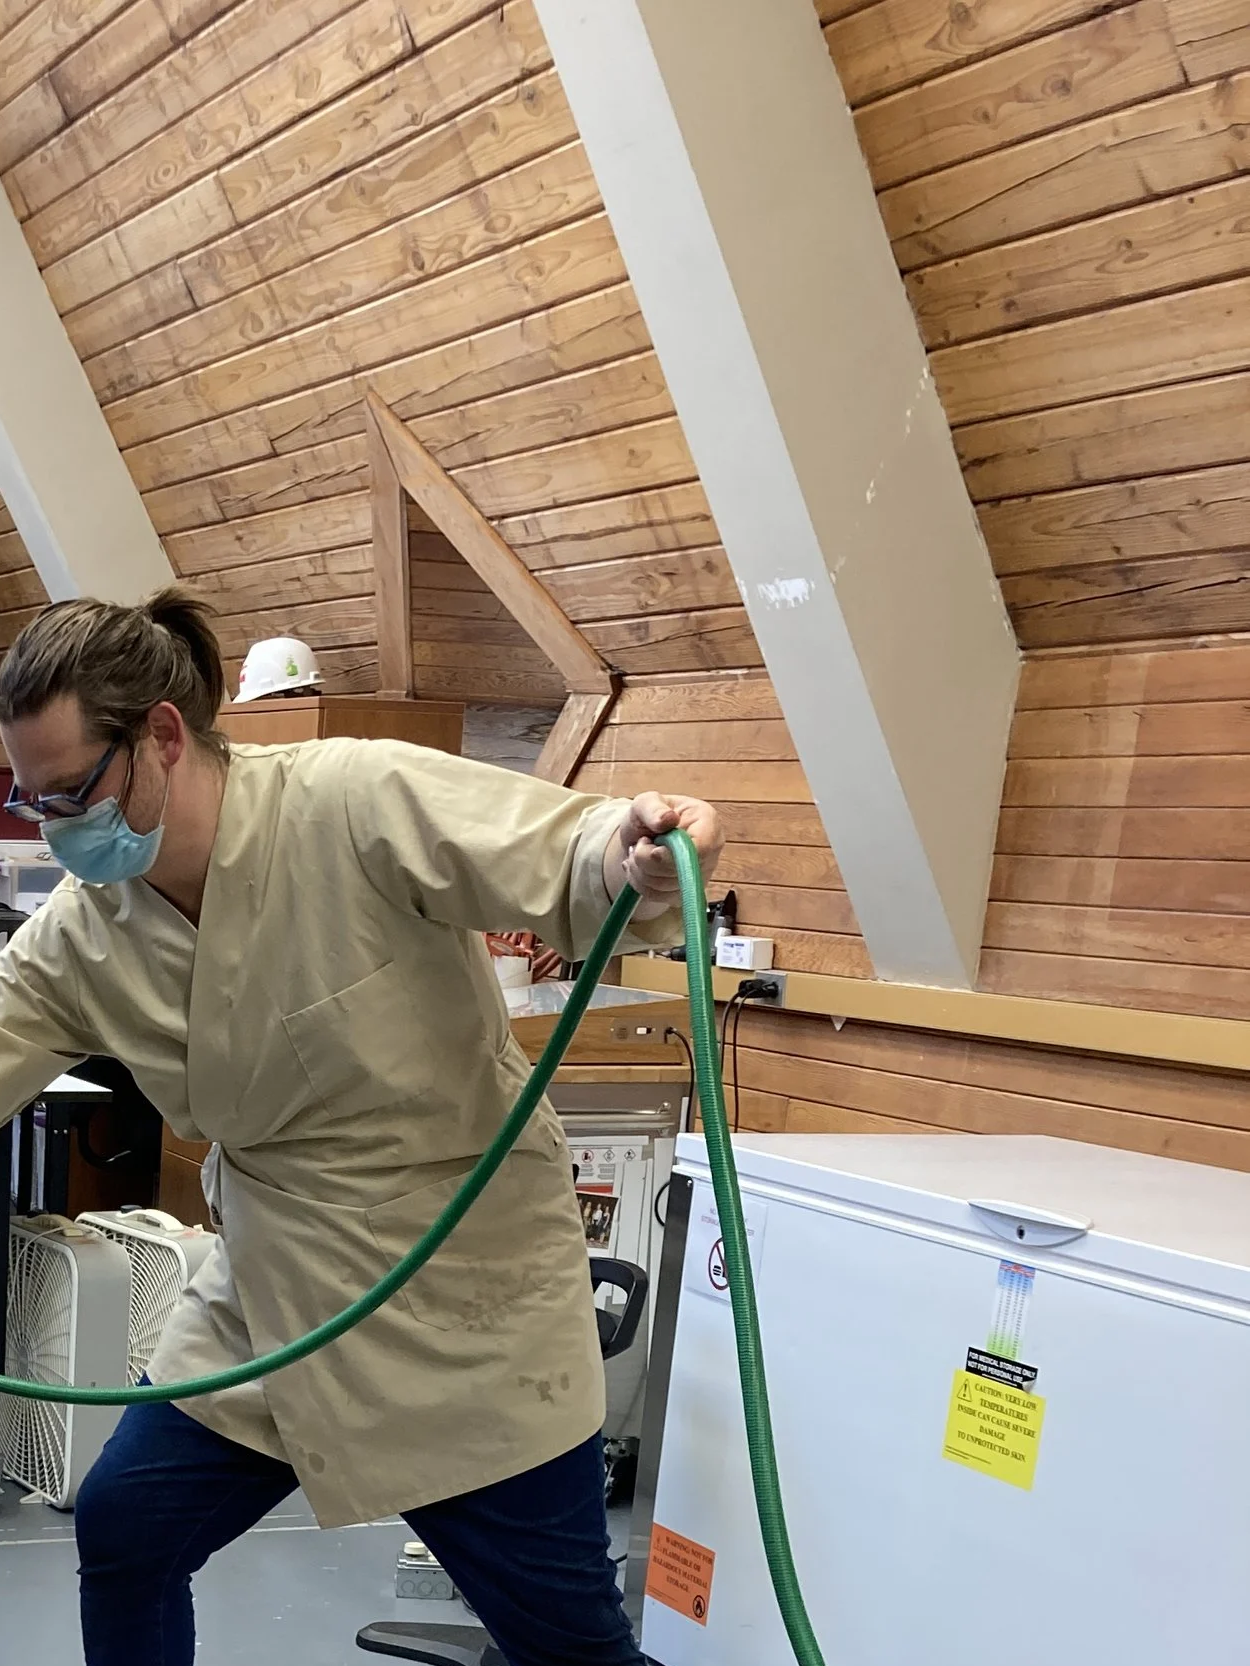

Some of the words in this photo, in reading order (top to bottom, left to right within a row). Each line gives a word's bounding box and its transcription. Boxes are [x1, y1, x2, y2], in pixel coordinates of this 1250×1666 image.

[969, 1351, 979, 1361] FOR
[1021, 1368, 1036, 1379] ONLY
[980, 1398, 1029, 1422] TEMPERATURES
[1005, 1393, 1023, 1406] VERY
[1022, 1399, 1037, 1410] LOW
[957, 1403, 977, 1418] INSIDE
[977, 1411, 991, 1421] CAN
[990, 1416, 1011, 1430] CAUSE
[1012, 1423, 1036, 1438] SEVERE
[979, 1425, 1006, 1441] DAMAGE
[957, 1430, 967, 1440] TO
[966, 1433, 1011, 1457] UNPROTECTED
